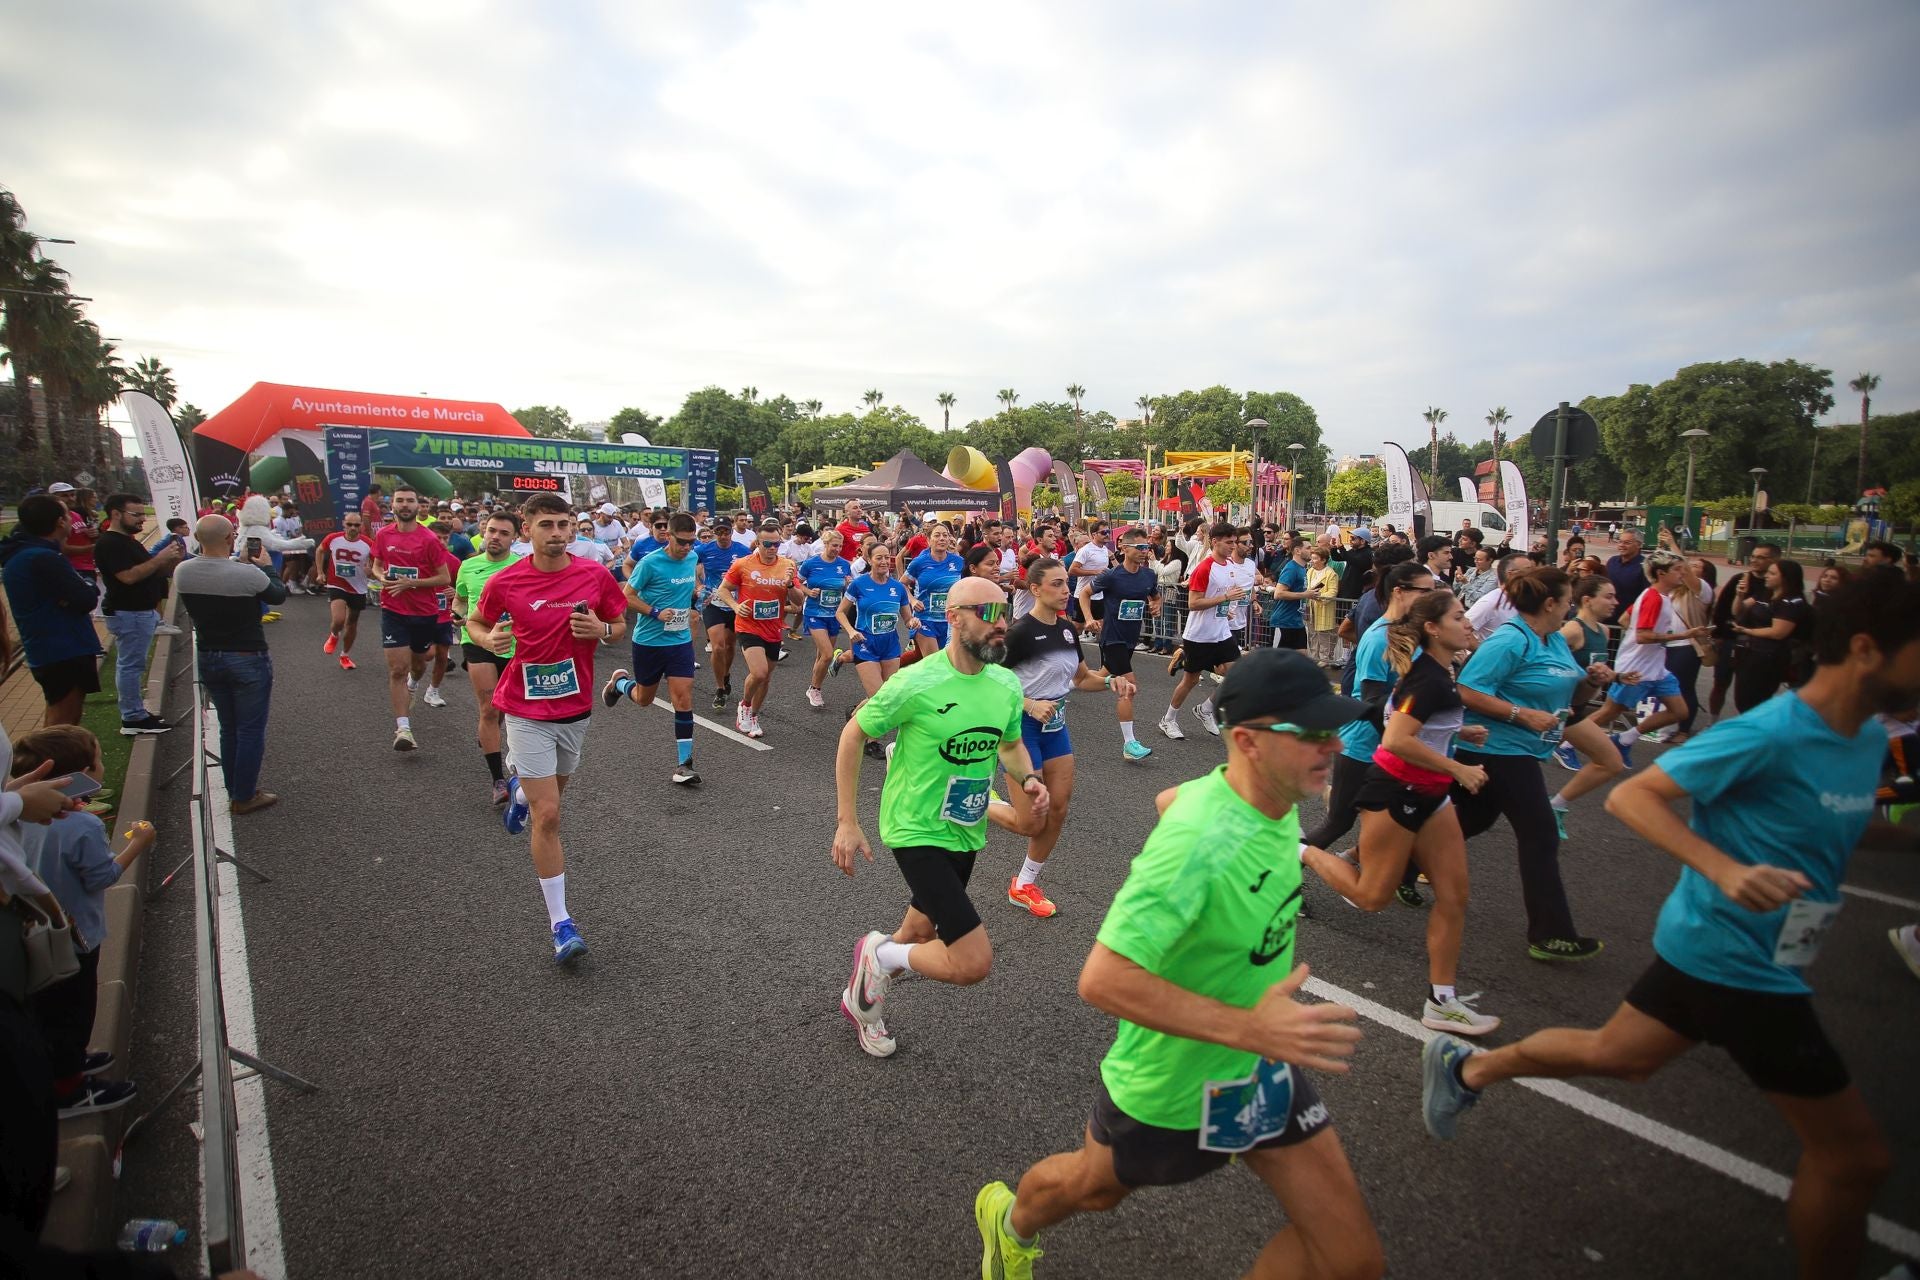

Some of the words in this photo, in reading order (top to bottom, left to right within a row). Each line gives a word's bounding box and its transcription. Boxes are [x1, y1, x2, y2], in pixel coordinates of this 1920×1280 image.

[292, 398, 407, 417] Ayuntamiento
[411, 407, 429, 419] de
[433, 408, 484, 423] Murcia
[462, 441, 558, 461] CARRERA
[562, 447, 585, 463] DE
[587, 449, 683, 468] EMPRESAS
[446, 458, 461, 466] LA
[461, 459, 504, 468] VERDAD
[534, 461, 588, 474] SALIDA
[615, 466, 628, 474] LA
[628, 467, 662, 476] VERDAD
[513, 477, 558, 490] 0:00:06
[535, 672, 568, 685] 1206
[946, 737, 998, 757] Fripoz
